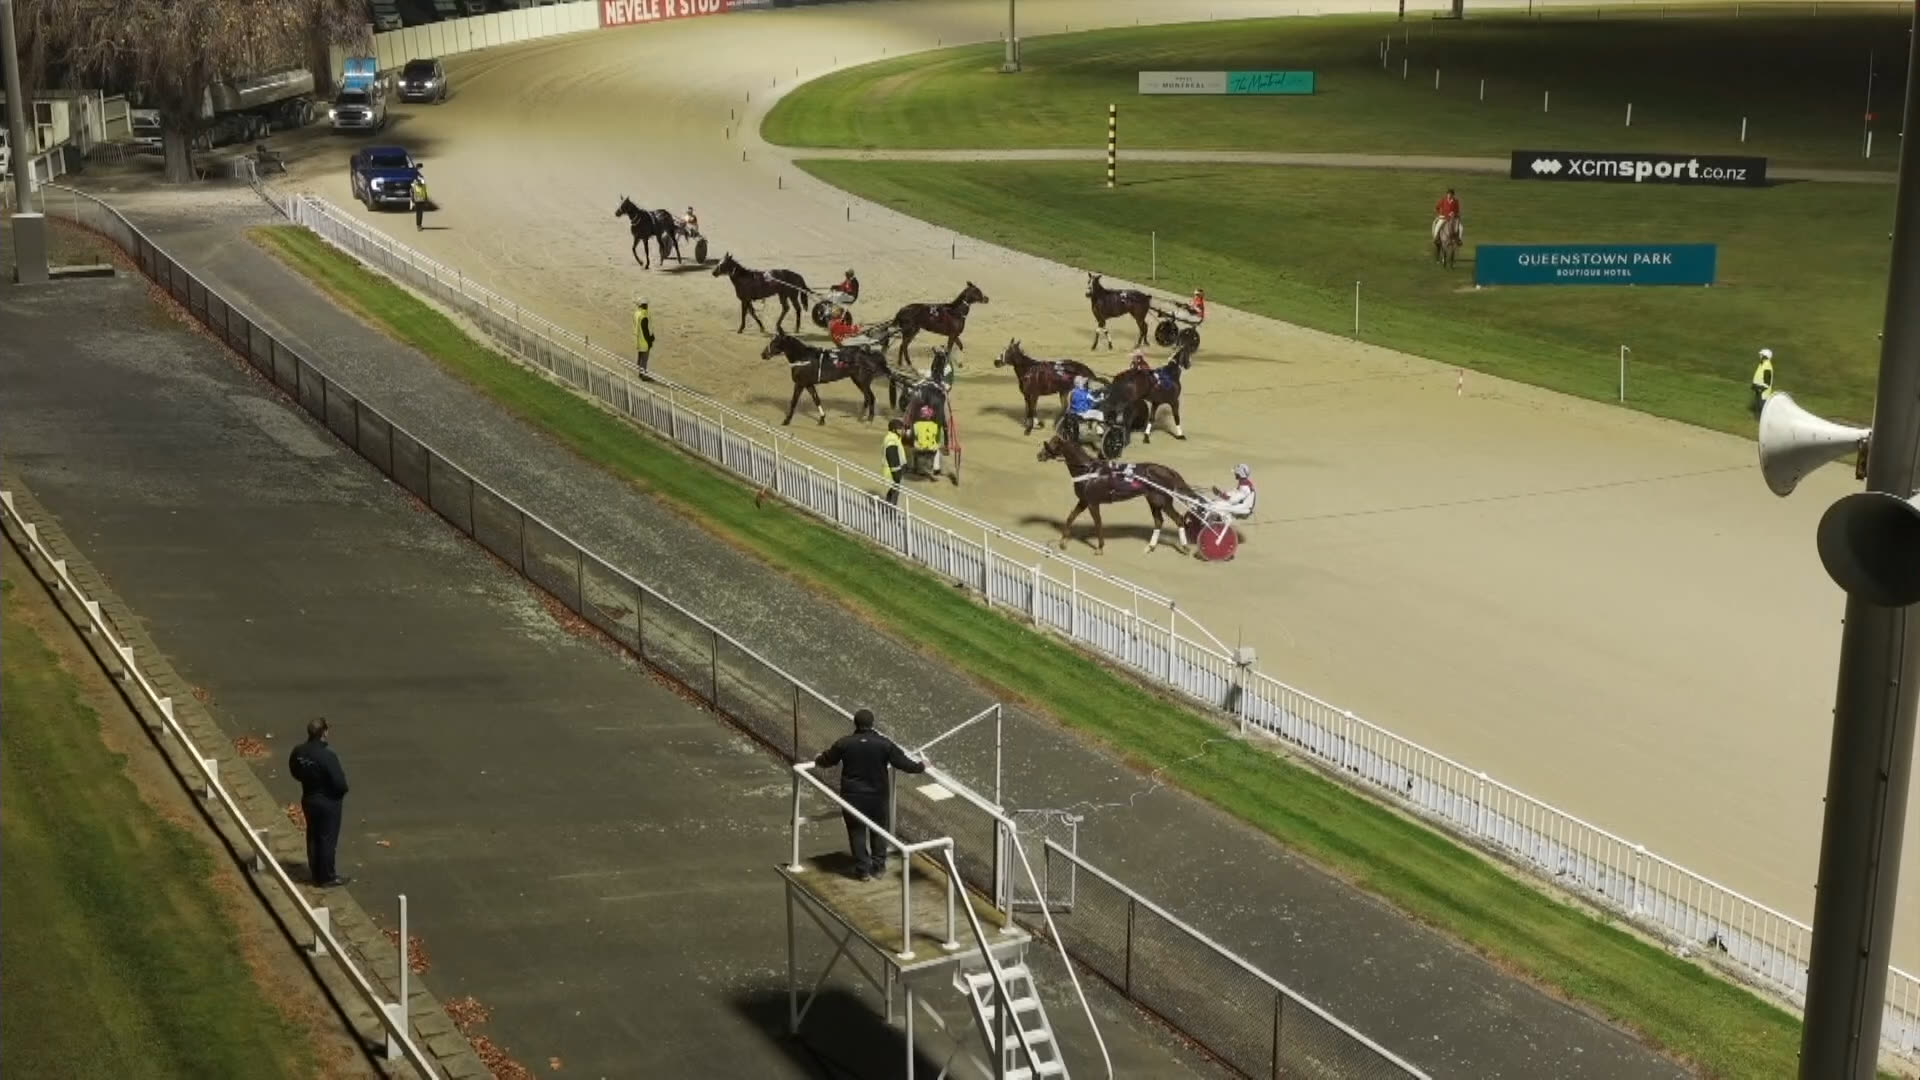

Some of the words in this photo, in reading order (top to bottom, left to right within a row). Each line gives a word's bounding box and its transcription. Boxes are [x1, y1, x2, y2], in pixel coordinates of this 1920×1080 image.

[605, 0, 660, 24] NEVELE
[665, 0, 676, 17] R
[681, 0, 720, 15] STUD
[1568, 158, 1747, 182] xcmsport.co.nz
[1518, 253, 1628, 265] QUEENSTOWN
[1633, 253, 1672, 264] PARK
[1556, 269, 1601, 277] BOUTIQUE
